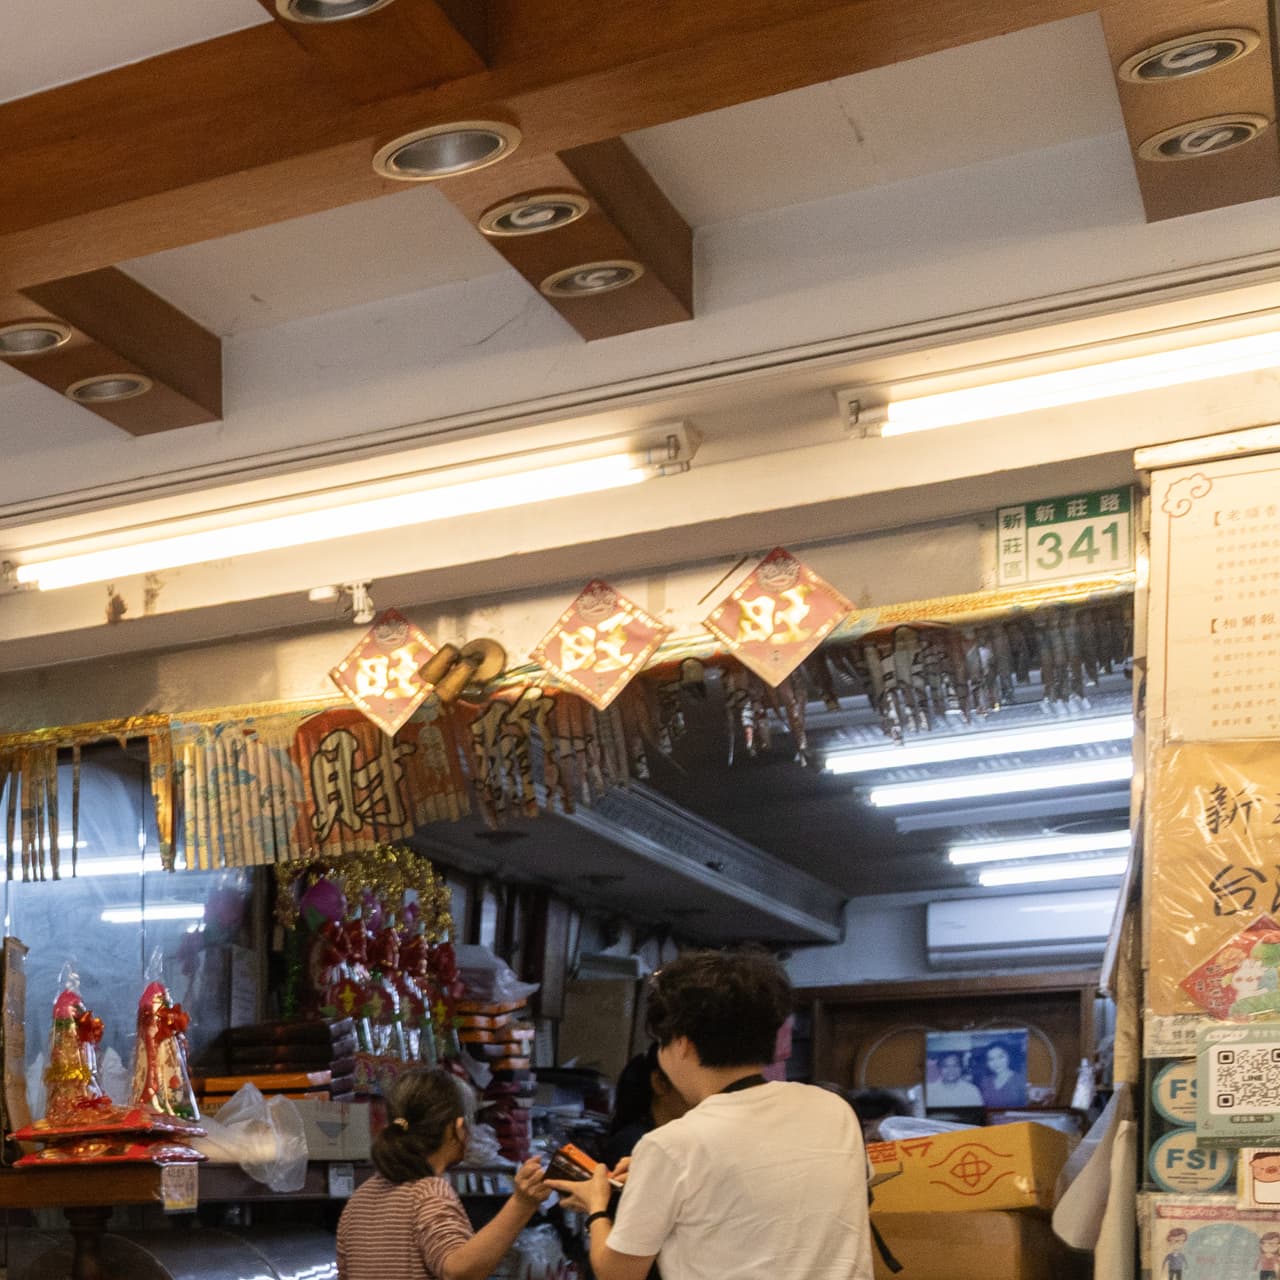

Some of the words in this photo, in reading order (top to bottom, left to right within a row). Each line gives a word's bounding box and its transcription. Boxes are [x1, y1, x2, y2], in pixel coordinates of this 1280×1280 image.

[1035, 493, 1120, 522] 新莊路
[1003, 512, 1022, 578] 新莊區
[1036, 521, 1119, 570] 341
[559, 612, 634, 673] 旺
[740, 585, 811, 645] 旺
[356, 643, 420, 700] 旺
[1166, 1149, 1217, 1169] FSI
